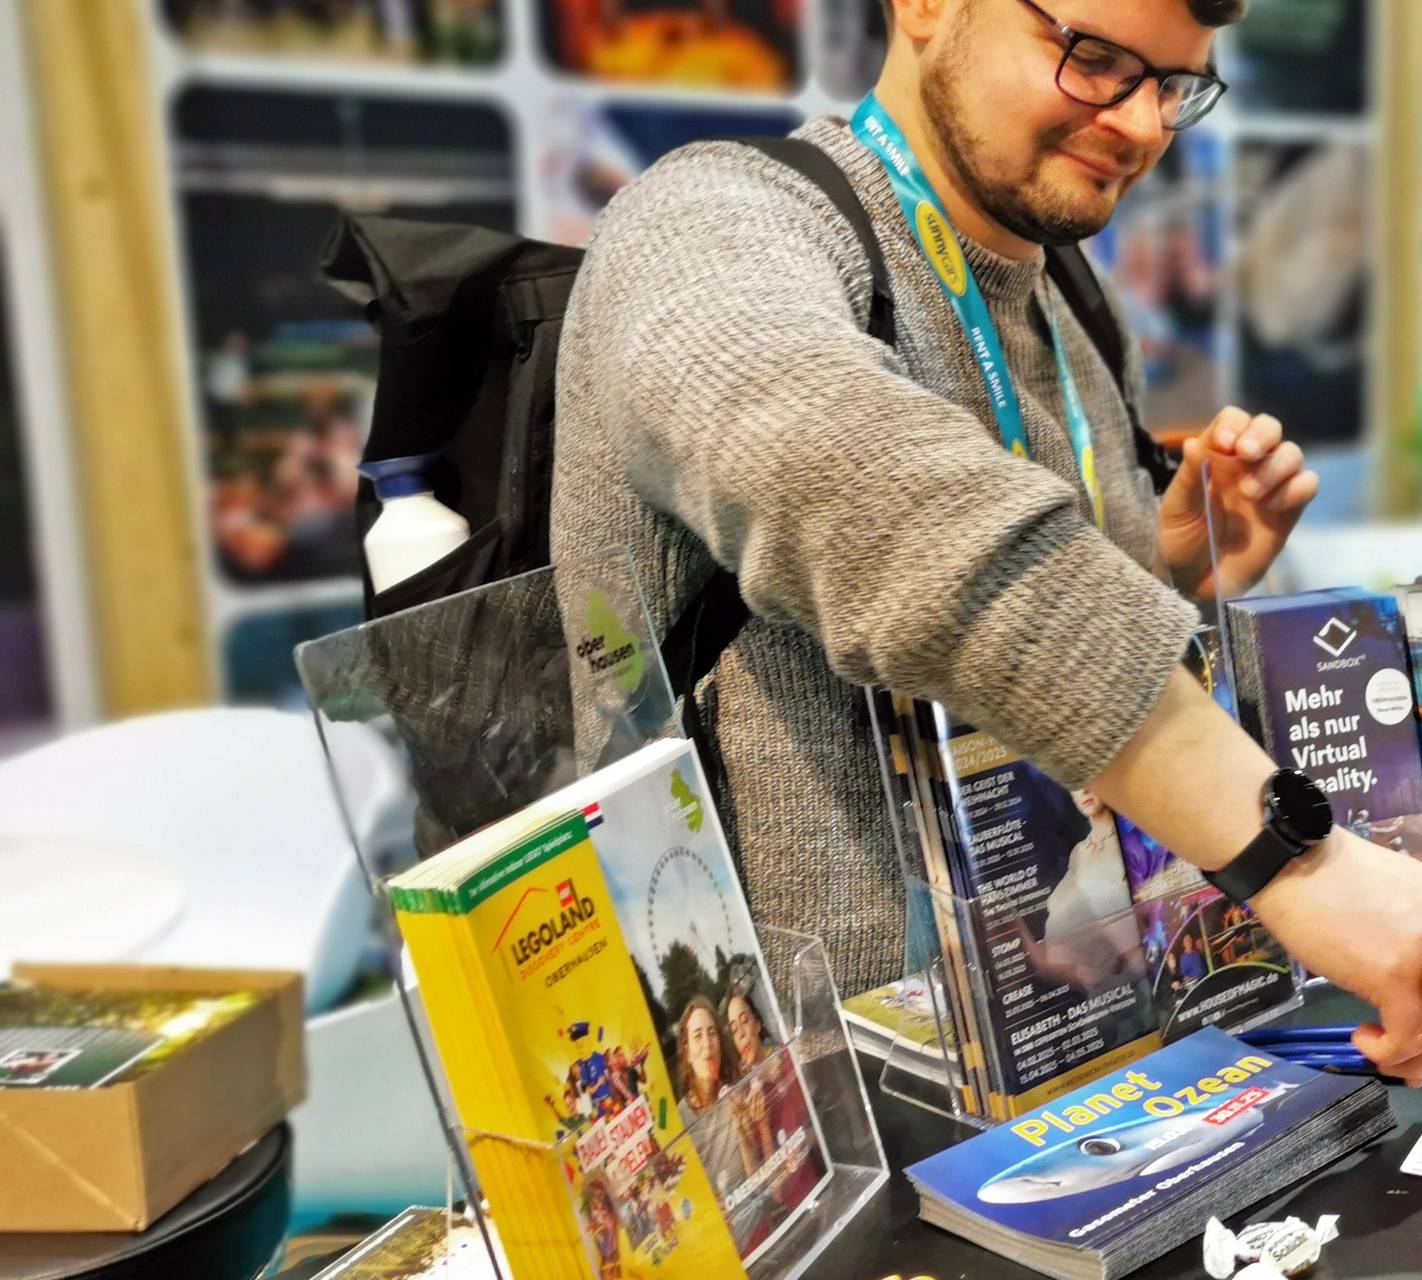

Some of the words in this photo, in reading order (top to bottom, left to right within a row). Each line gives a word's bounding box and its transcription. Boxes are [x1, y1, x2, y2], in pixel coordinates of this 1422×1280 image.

[877, 134, 888, 146] A
[887, 142, 910, 176] SMILE
[971, 327, 990, 360] RENT
[982, 361, 994, 373] A
[987, 371, 1008, 408] SMILE
[577, 633, 605, 657] ober
[590, 642, 636, 673] hausen
[1316, 656, 1361, 672] SANDBOX
[1285, 684, 1343, 713] Mehr
[1289, 716, 1321, 741] als
[1324, 714, 1360, 736] nur
[1291, 735, 1368, 769] Virtual
[1314, 766, 1378, 793] eality.
[986, 830, 1025, 853] MUSICAL
[976, 881, 994, 895] THE
[994, 869, 1025, 889] WORLD
[1025, 864, 1039, 879] OF
[1004, 877, 1040, 898] ZIMMER
[511, 890, 595, 966] LEGOLAND
[519, 944, 564, 980] DISCOVERY
[544, 936, 608, 988] OBERHAUSEN
[991, 937, 1022, 958] STOMP
[1002, 983, 1034, 1006] GREASE
[1010, 1013, 1062, 1046] ELISABETH
[1067, 1002, 1089, 1020] DAS
[1088, 983, 1134, 1010] MUSICAL
[1143, 1055, 1274, 1118] Ozean
[1010, 1070, 1162, 1147] Planet
[1068, 1188, 1157, 1238] Gasometer
[1155, 1141, 1247, 1190] Oberhausen
